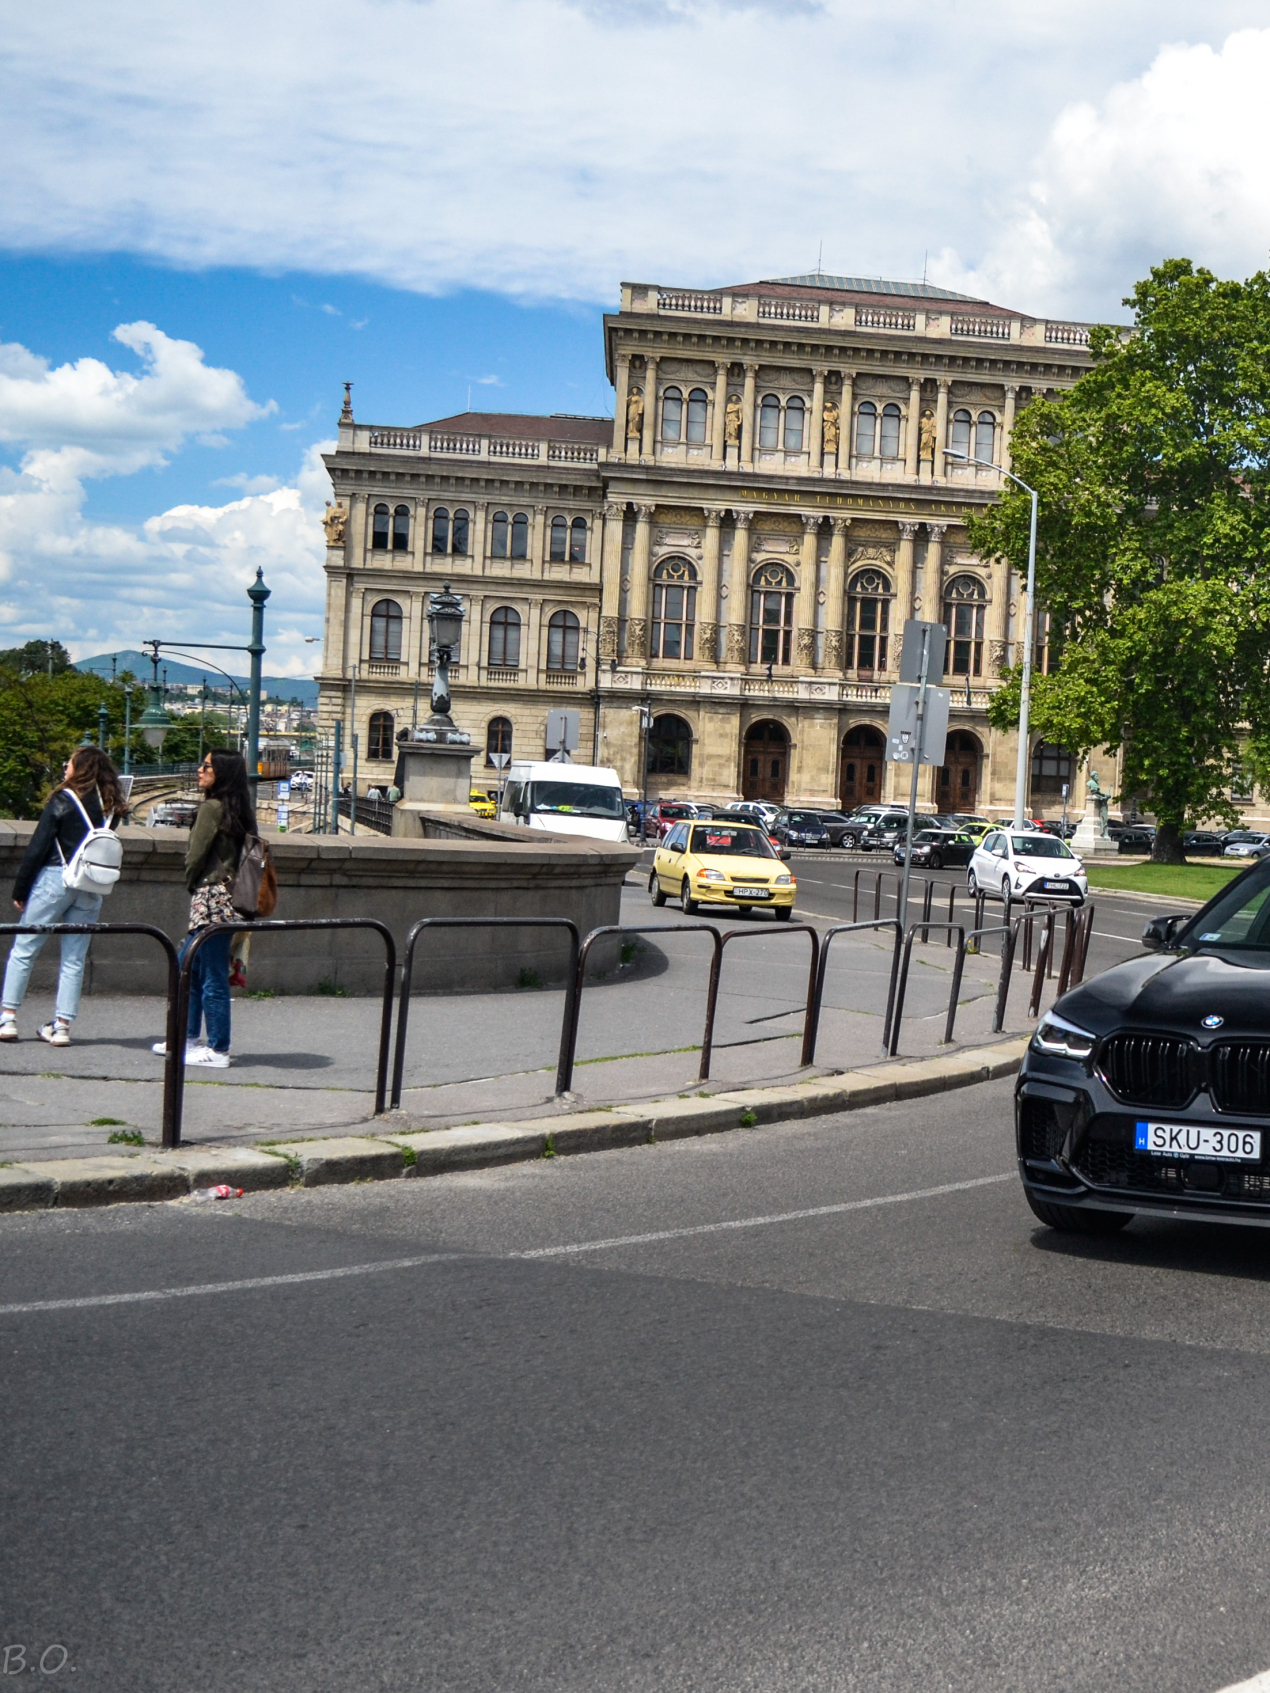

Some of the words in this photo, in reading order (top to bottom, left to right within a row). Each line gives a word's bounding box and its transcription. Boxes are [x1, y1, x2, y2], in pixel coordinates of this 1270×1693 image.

[741, 490, 800, 502] MAGYAR
[738, 888, 769, 897] HPX-270
[1138, 1137, 1145, 1146] H
[1152, 1126, 1255, 1155] SKU-306
